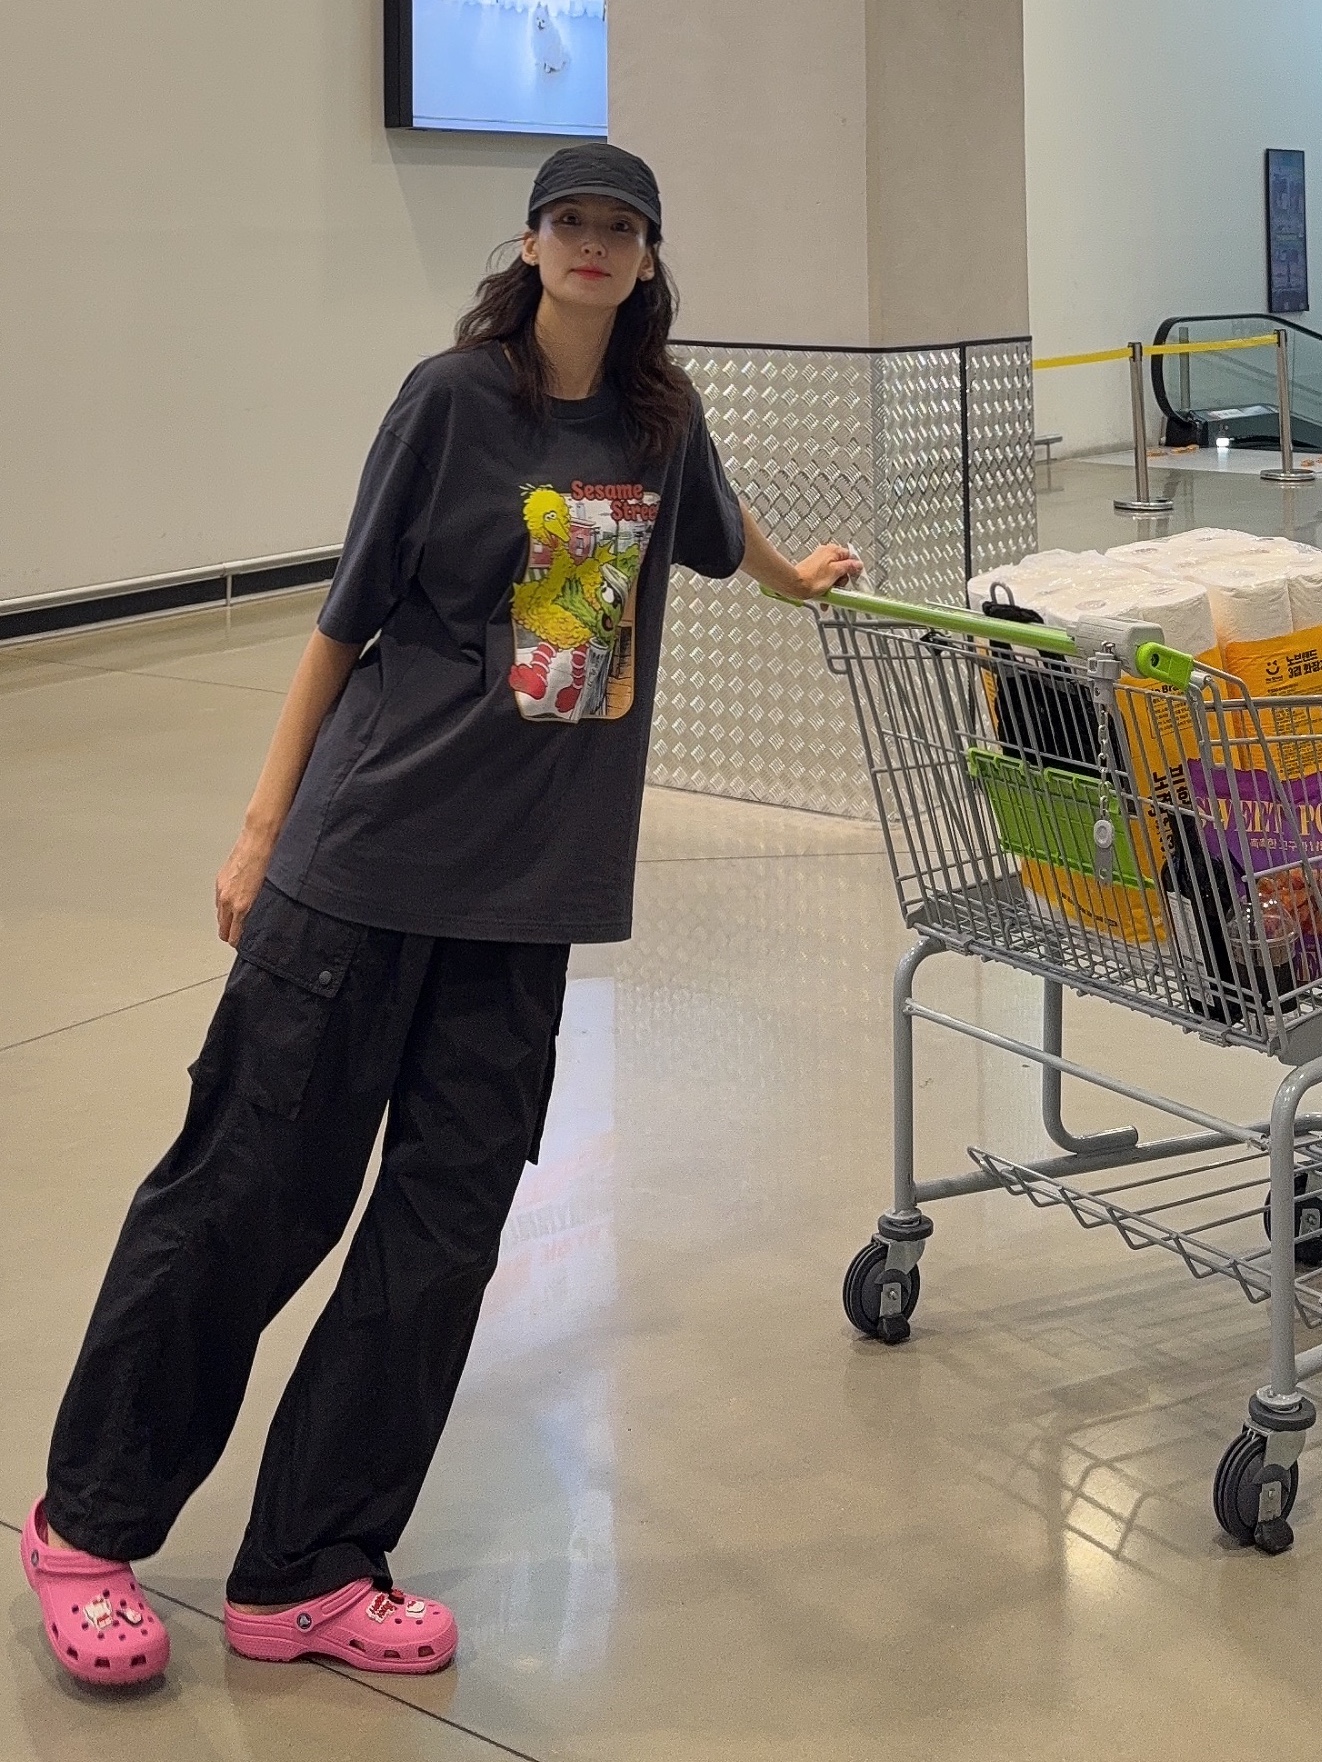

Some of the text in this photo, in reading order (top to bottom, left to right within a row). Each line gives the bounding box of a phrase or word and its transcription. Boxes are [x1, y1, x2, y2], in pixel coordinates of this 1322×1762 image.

[572, 480, 644, 501] Sesame
[610, 500, 658, 521] Stree
[1286, 649, 1318, 667] 노브랜드
[1288, 665, 1302, 679] 3겹
[1195, 797, 1284, 834] SWEET
